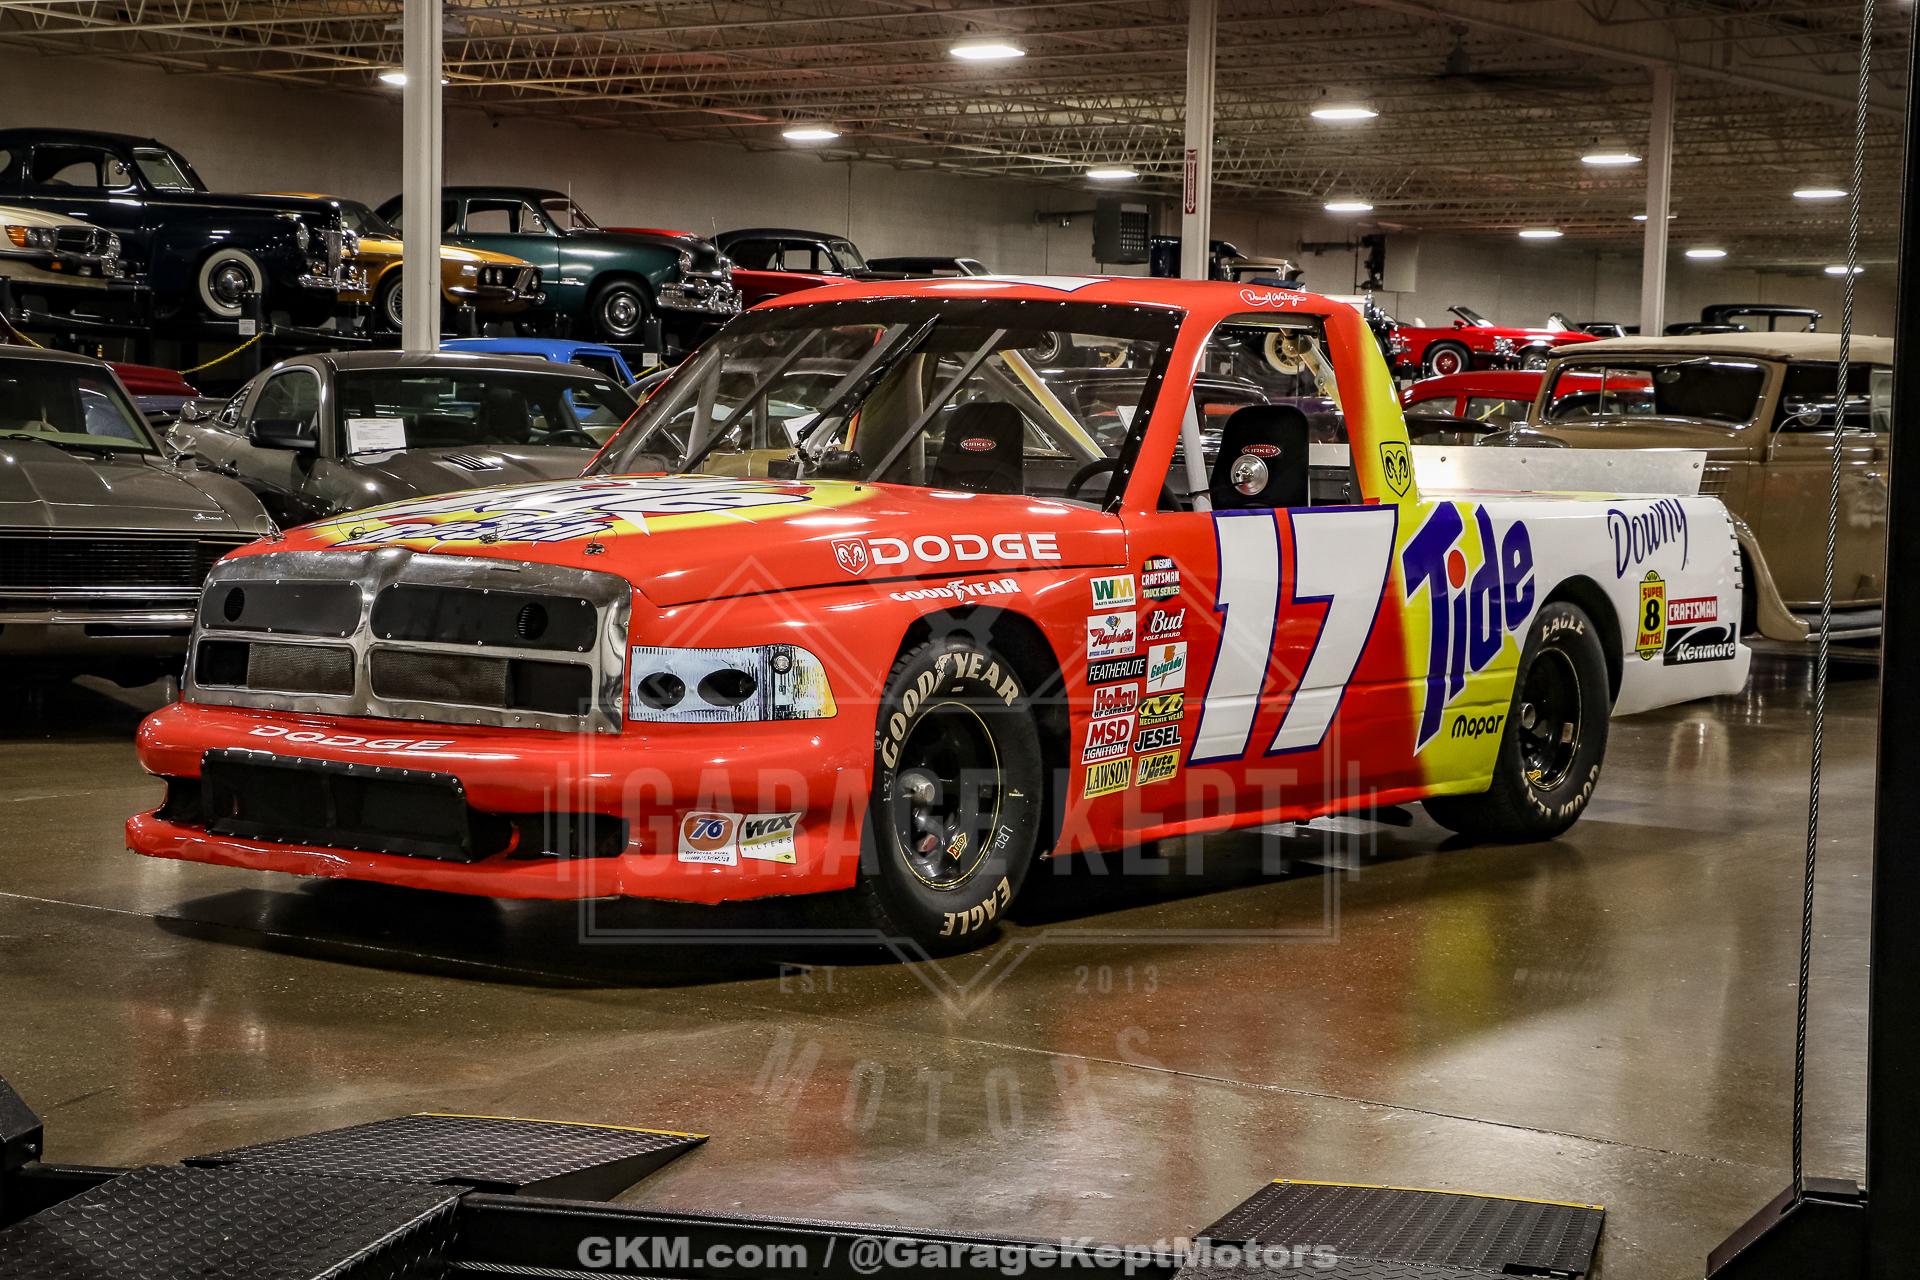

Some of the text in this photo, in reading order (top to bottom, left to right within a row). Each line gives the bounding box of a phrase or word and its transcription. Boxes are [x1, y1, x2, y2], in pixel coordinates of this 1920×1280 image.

[868, 532, 1062, 565] DODGE
[1607, 498, 1688, 579] Downy
[889, 578, 1022, 602] GOODYEAR
[1093, 577, 1134, 601] WM
[1141, 570, 1181, 586] CRAFTSMAN
[1142, 585, 1181, 599] TRUCK SERIES
[1642, 585, 1664, 601] SUPER
[1150, 608, 1186, 634] Bud
[1643, 598, 1660, 632] 8
[1667, 599, 1717, 622] CRAFTSMAN
[1142, 631, 1181, 642] POLE AWARD
[1186, 504, 1398, 767] 17
[1402, 502, 1536, 756] Tide
[1639, 631, 1662, 646] MOTEL
[1676, 641, 1735, 662] Kenmore
[1088, 658, 1146, 682] FEATHERLITE
[882, 652, 1019, 769] GOODYEAR
[1095, 687, 1137, 712] Holley
[1168, 710, 1184, 721] WEAR
[248, 725, 456, 750] DODGE
[1089, 719, 1130, 747] MSD
[1133, 725, 1181, 751] JESEL
[1086, 743, 1125, 760] IGNITION
[1150, 754, 1174, 768] Auto
[1086, 759, 1132, 791] LAWSON
[689, 817, 729, 840] 76
[745, 813, 798, 840] WIX
[939, 876, 1012, 936] EAGLE
